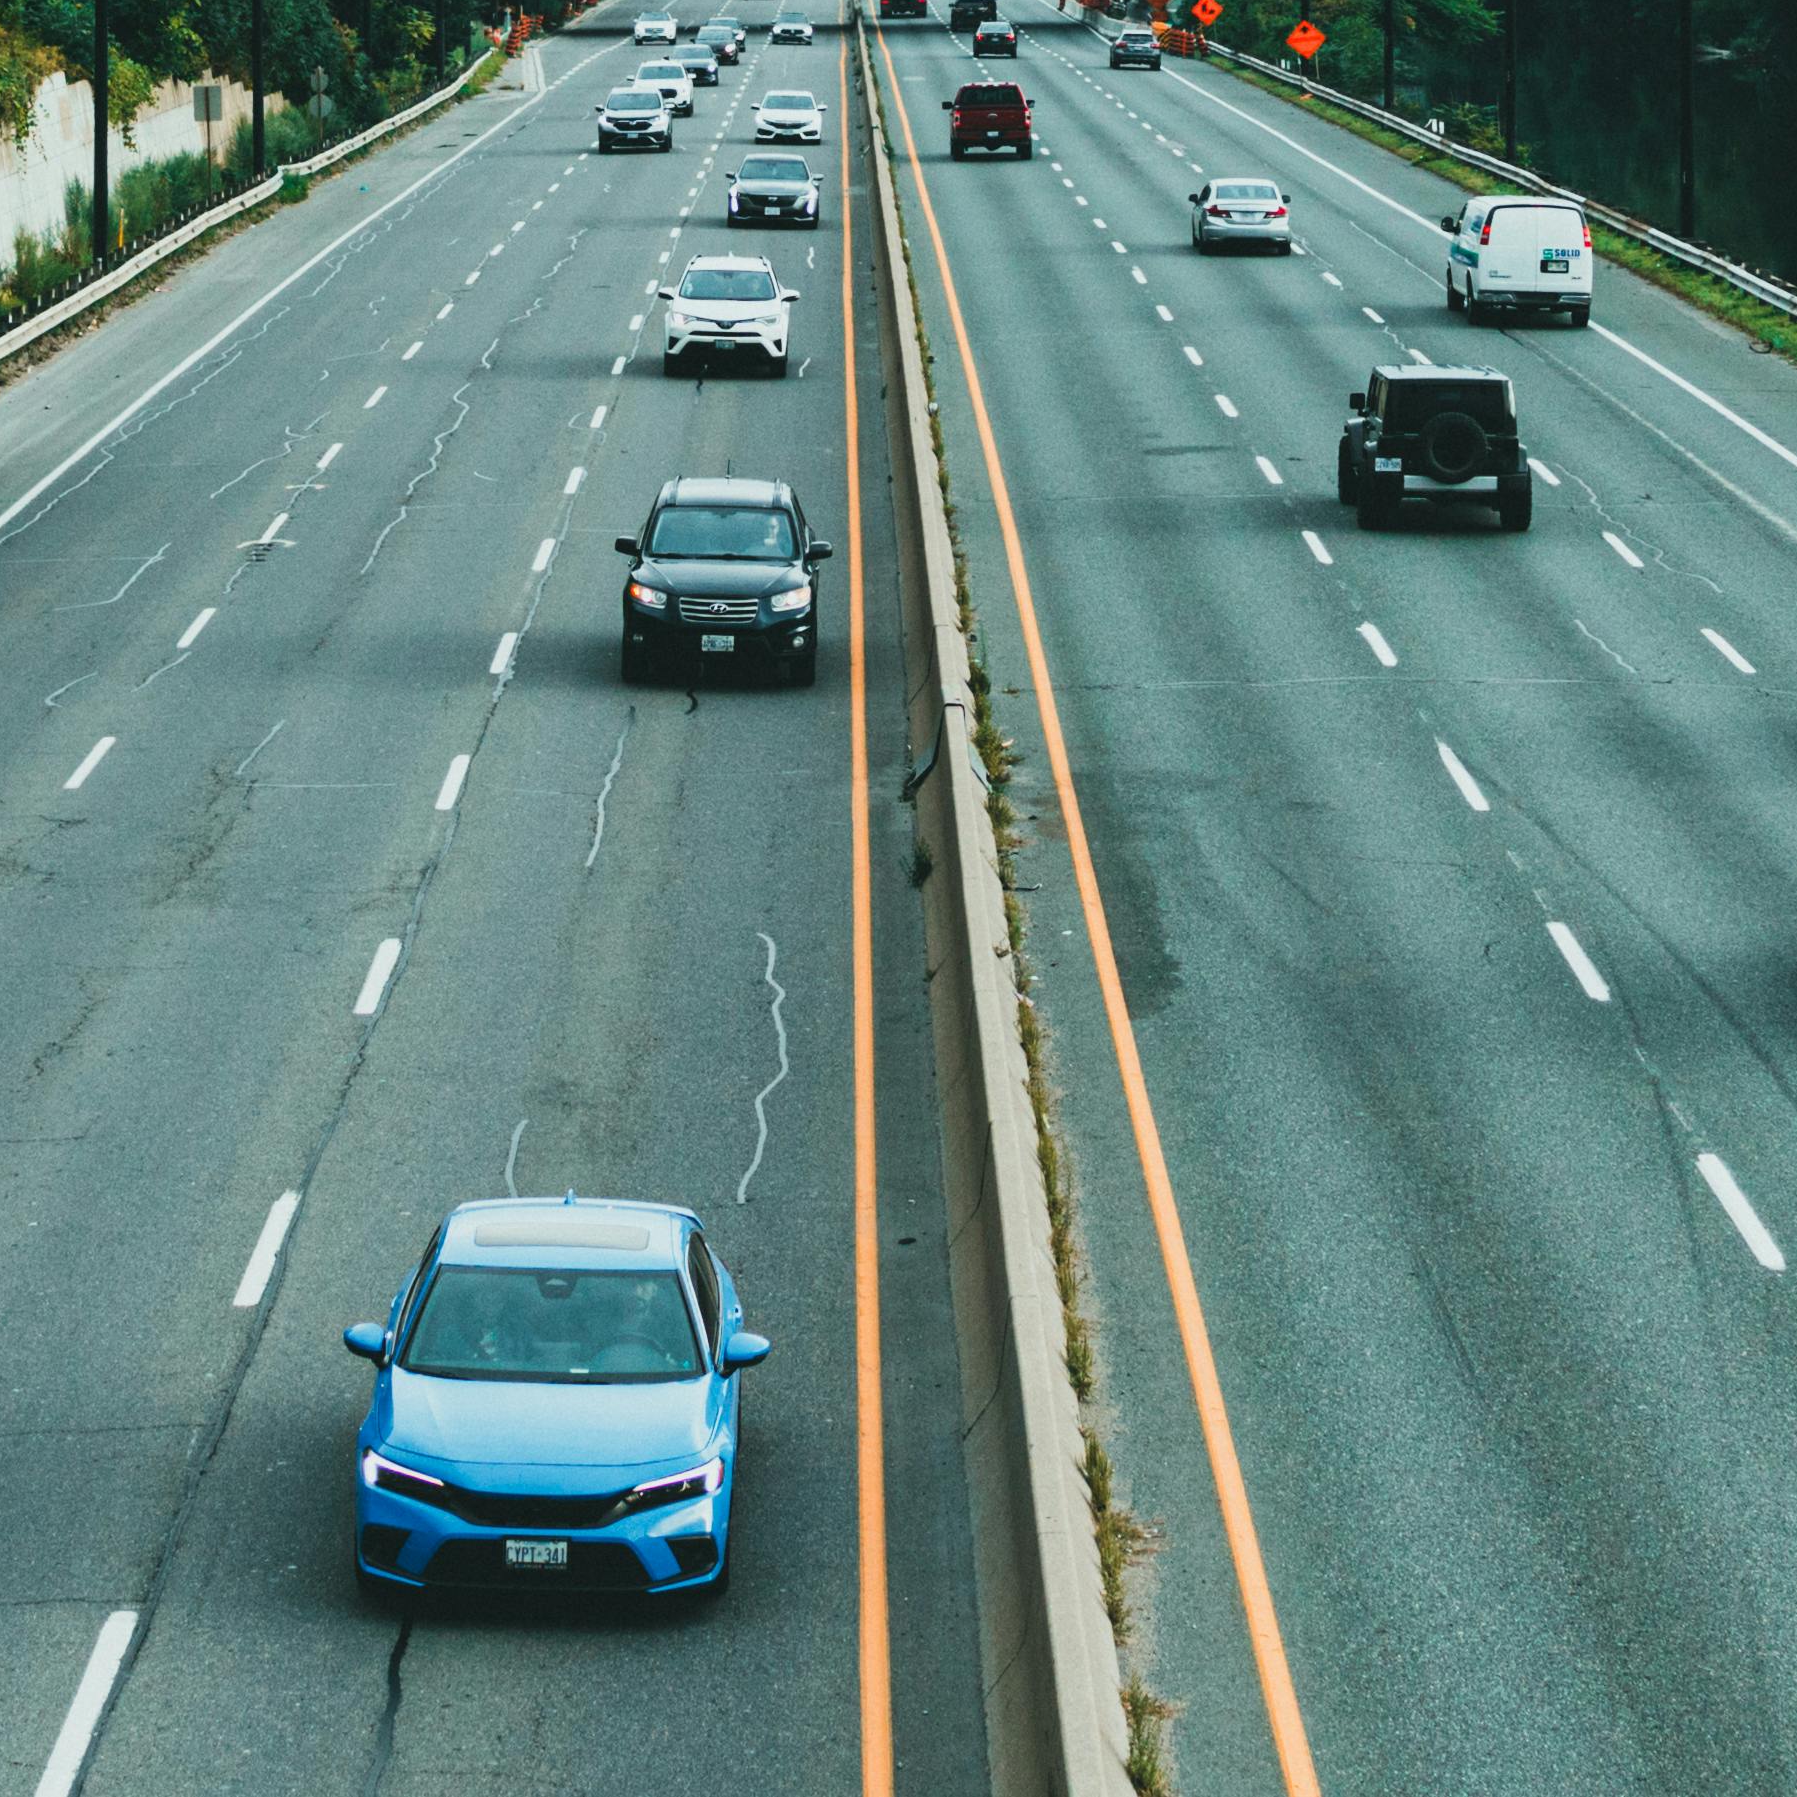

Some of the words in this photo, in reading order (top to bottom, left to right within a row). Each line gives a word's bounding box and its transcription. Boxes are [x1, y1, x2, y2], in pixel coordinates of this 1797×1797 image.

[1555, 249, 1581, 257] SOLID
[506, 1546, 537, 1564] CYPT
[544, 1547, 565, 1564] 341
